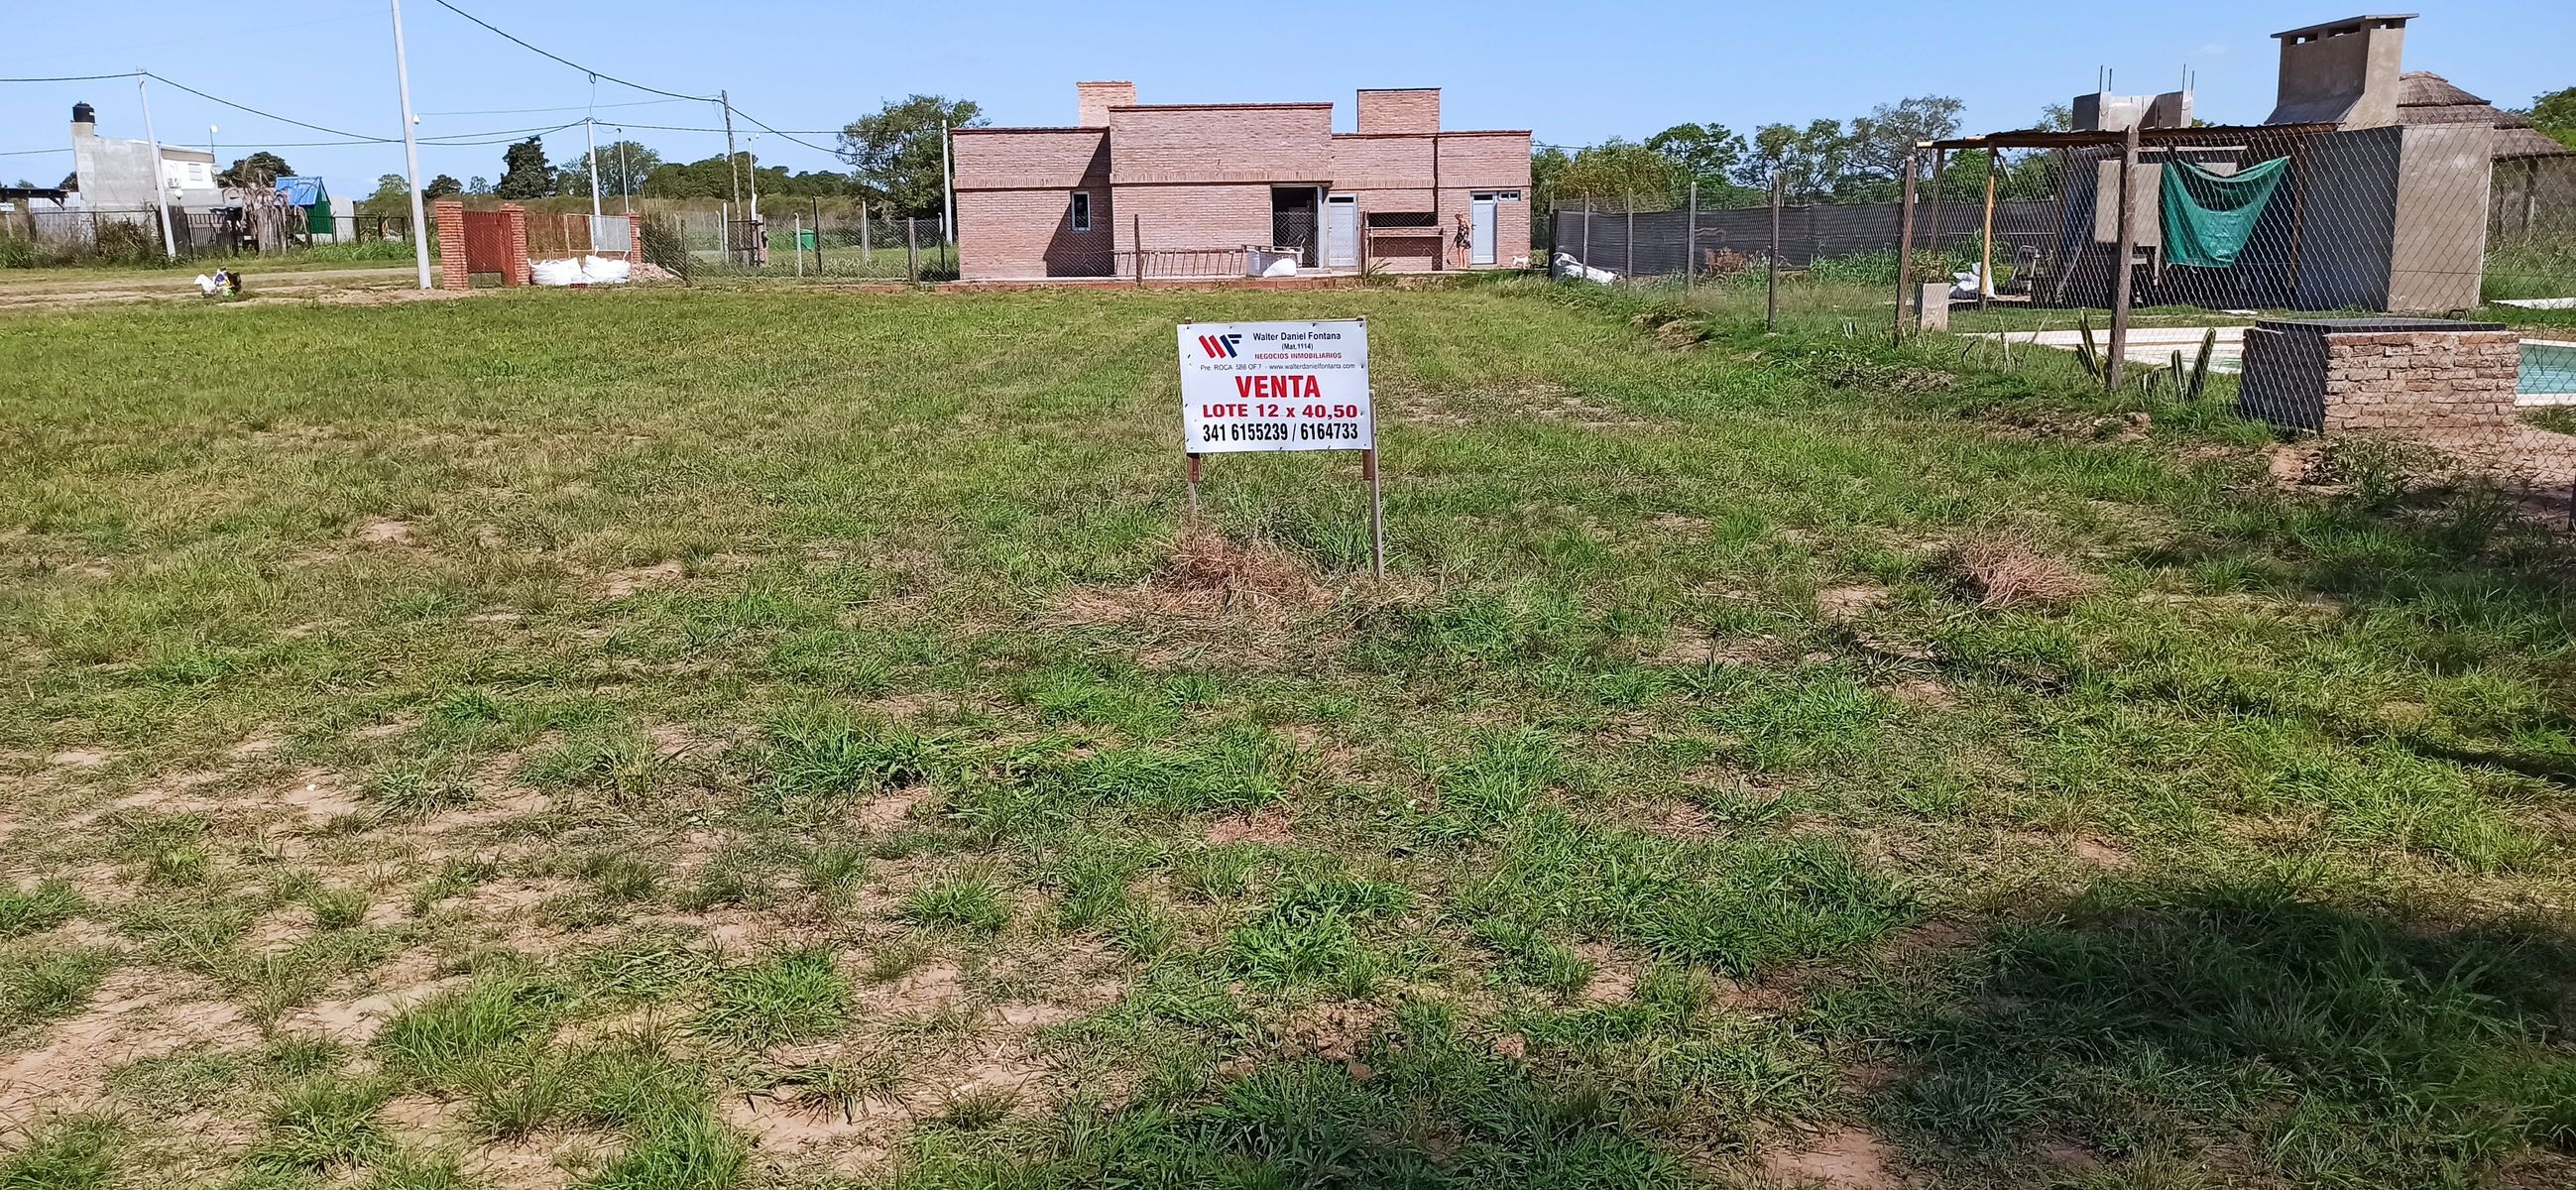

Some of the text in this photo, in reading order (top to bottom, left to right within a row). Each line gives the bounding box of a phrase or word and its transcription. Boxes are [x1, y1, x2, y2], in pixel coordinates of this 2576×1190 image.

[1253, 331, 1342, 341] Walter Daniel Fontana
[1235, 375, 1321, 398] VENTA
[1203, 404, 1248, 417] LOTE
[1256, 404, 1279, 417] 12
[1302, 405, 1357, 420] 40,50
[1203, 423, 1226, 442] 341
[1231, 422, 1288, 441] 6155239
[1300, 422, 1358, 440] 6164733
